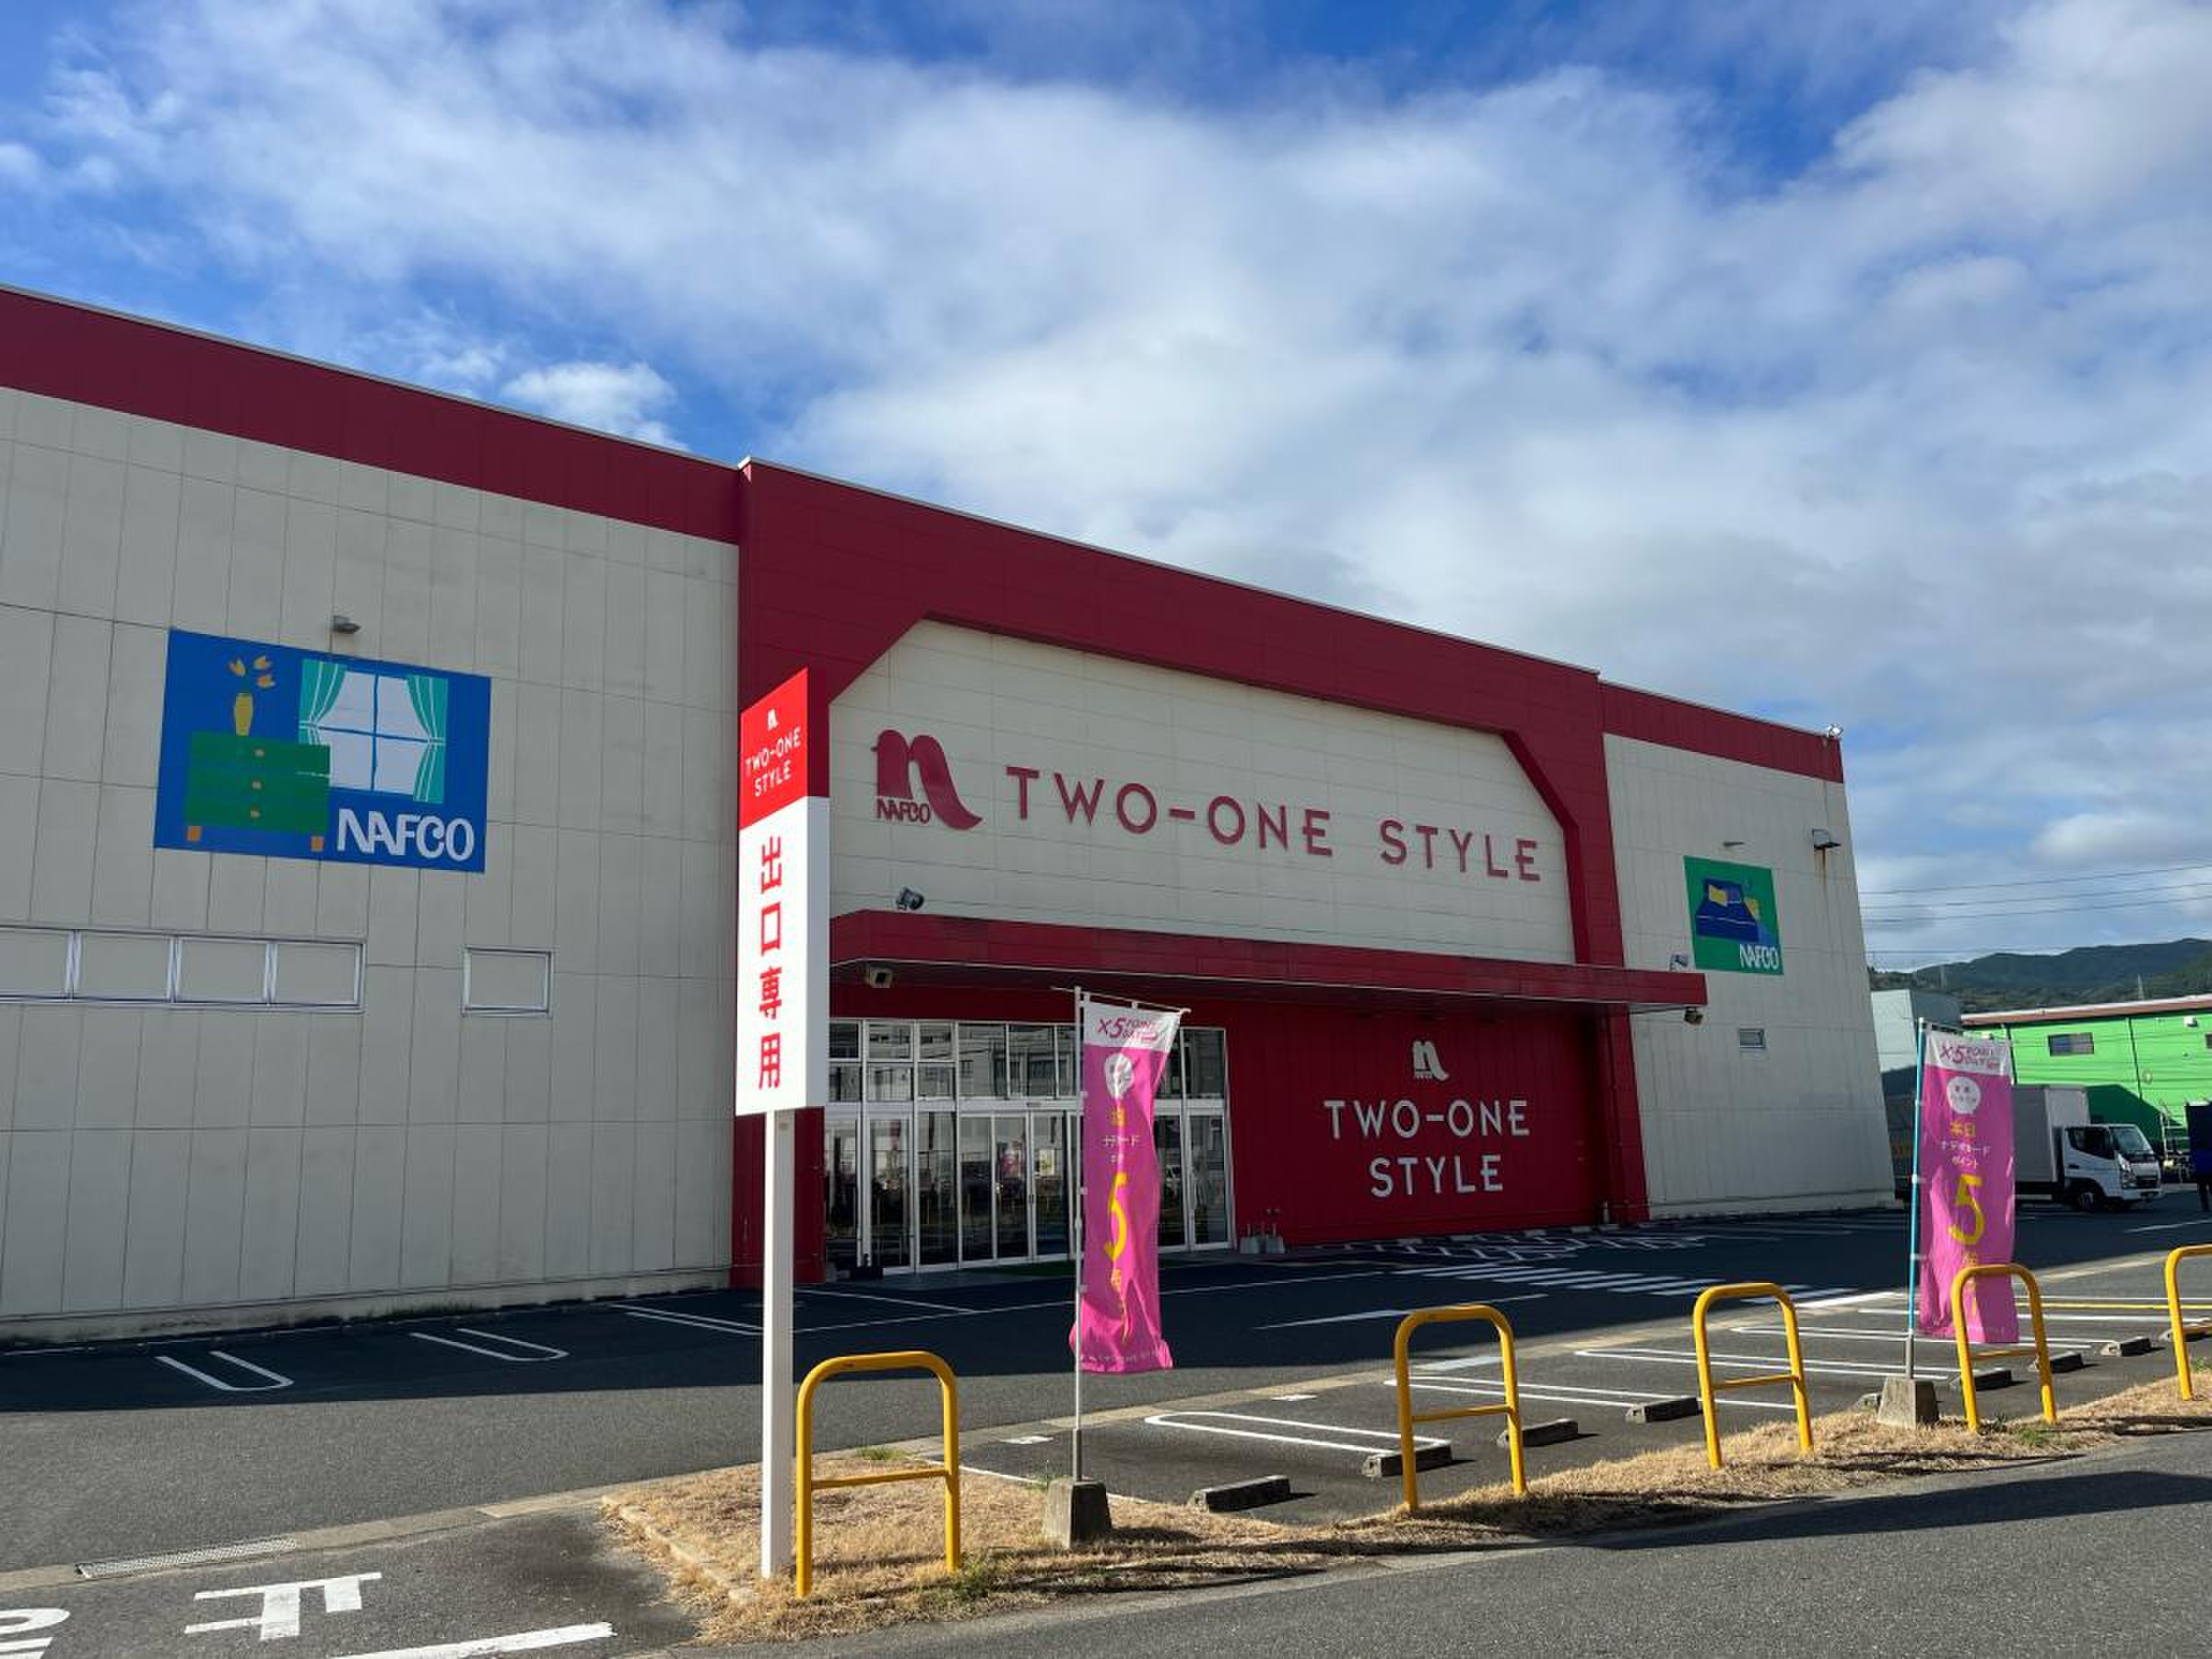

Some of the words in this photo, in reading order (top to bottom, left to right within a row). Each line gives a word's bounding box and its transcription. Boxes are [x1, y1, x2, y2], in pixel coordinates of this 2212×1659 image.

[745, 726, 800, 777] TWO-ONE
[755, 759, 791, 797] STYLE
[877, 798, 930, 824] NAFCO
[1006, 766, 1333, 857] TWO-ONE
[1380, 819, 1540, 881] STYLE
[336, 808, 475, 862] NAFCO
[759, 835, 782, 1090] 出口専用
[1739, 943, 1780, 971] NAFCO
[1324, 1100, 1530, 1140] TWO-ONE
[1370, 1154, 1504, 1197] STYLE
[1947, 1173, 1984, 1245] 5
